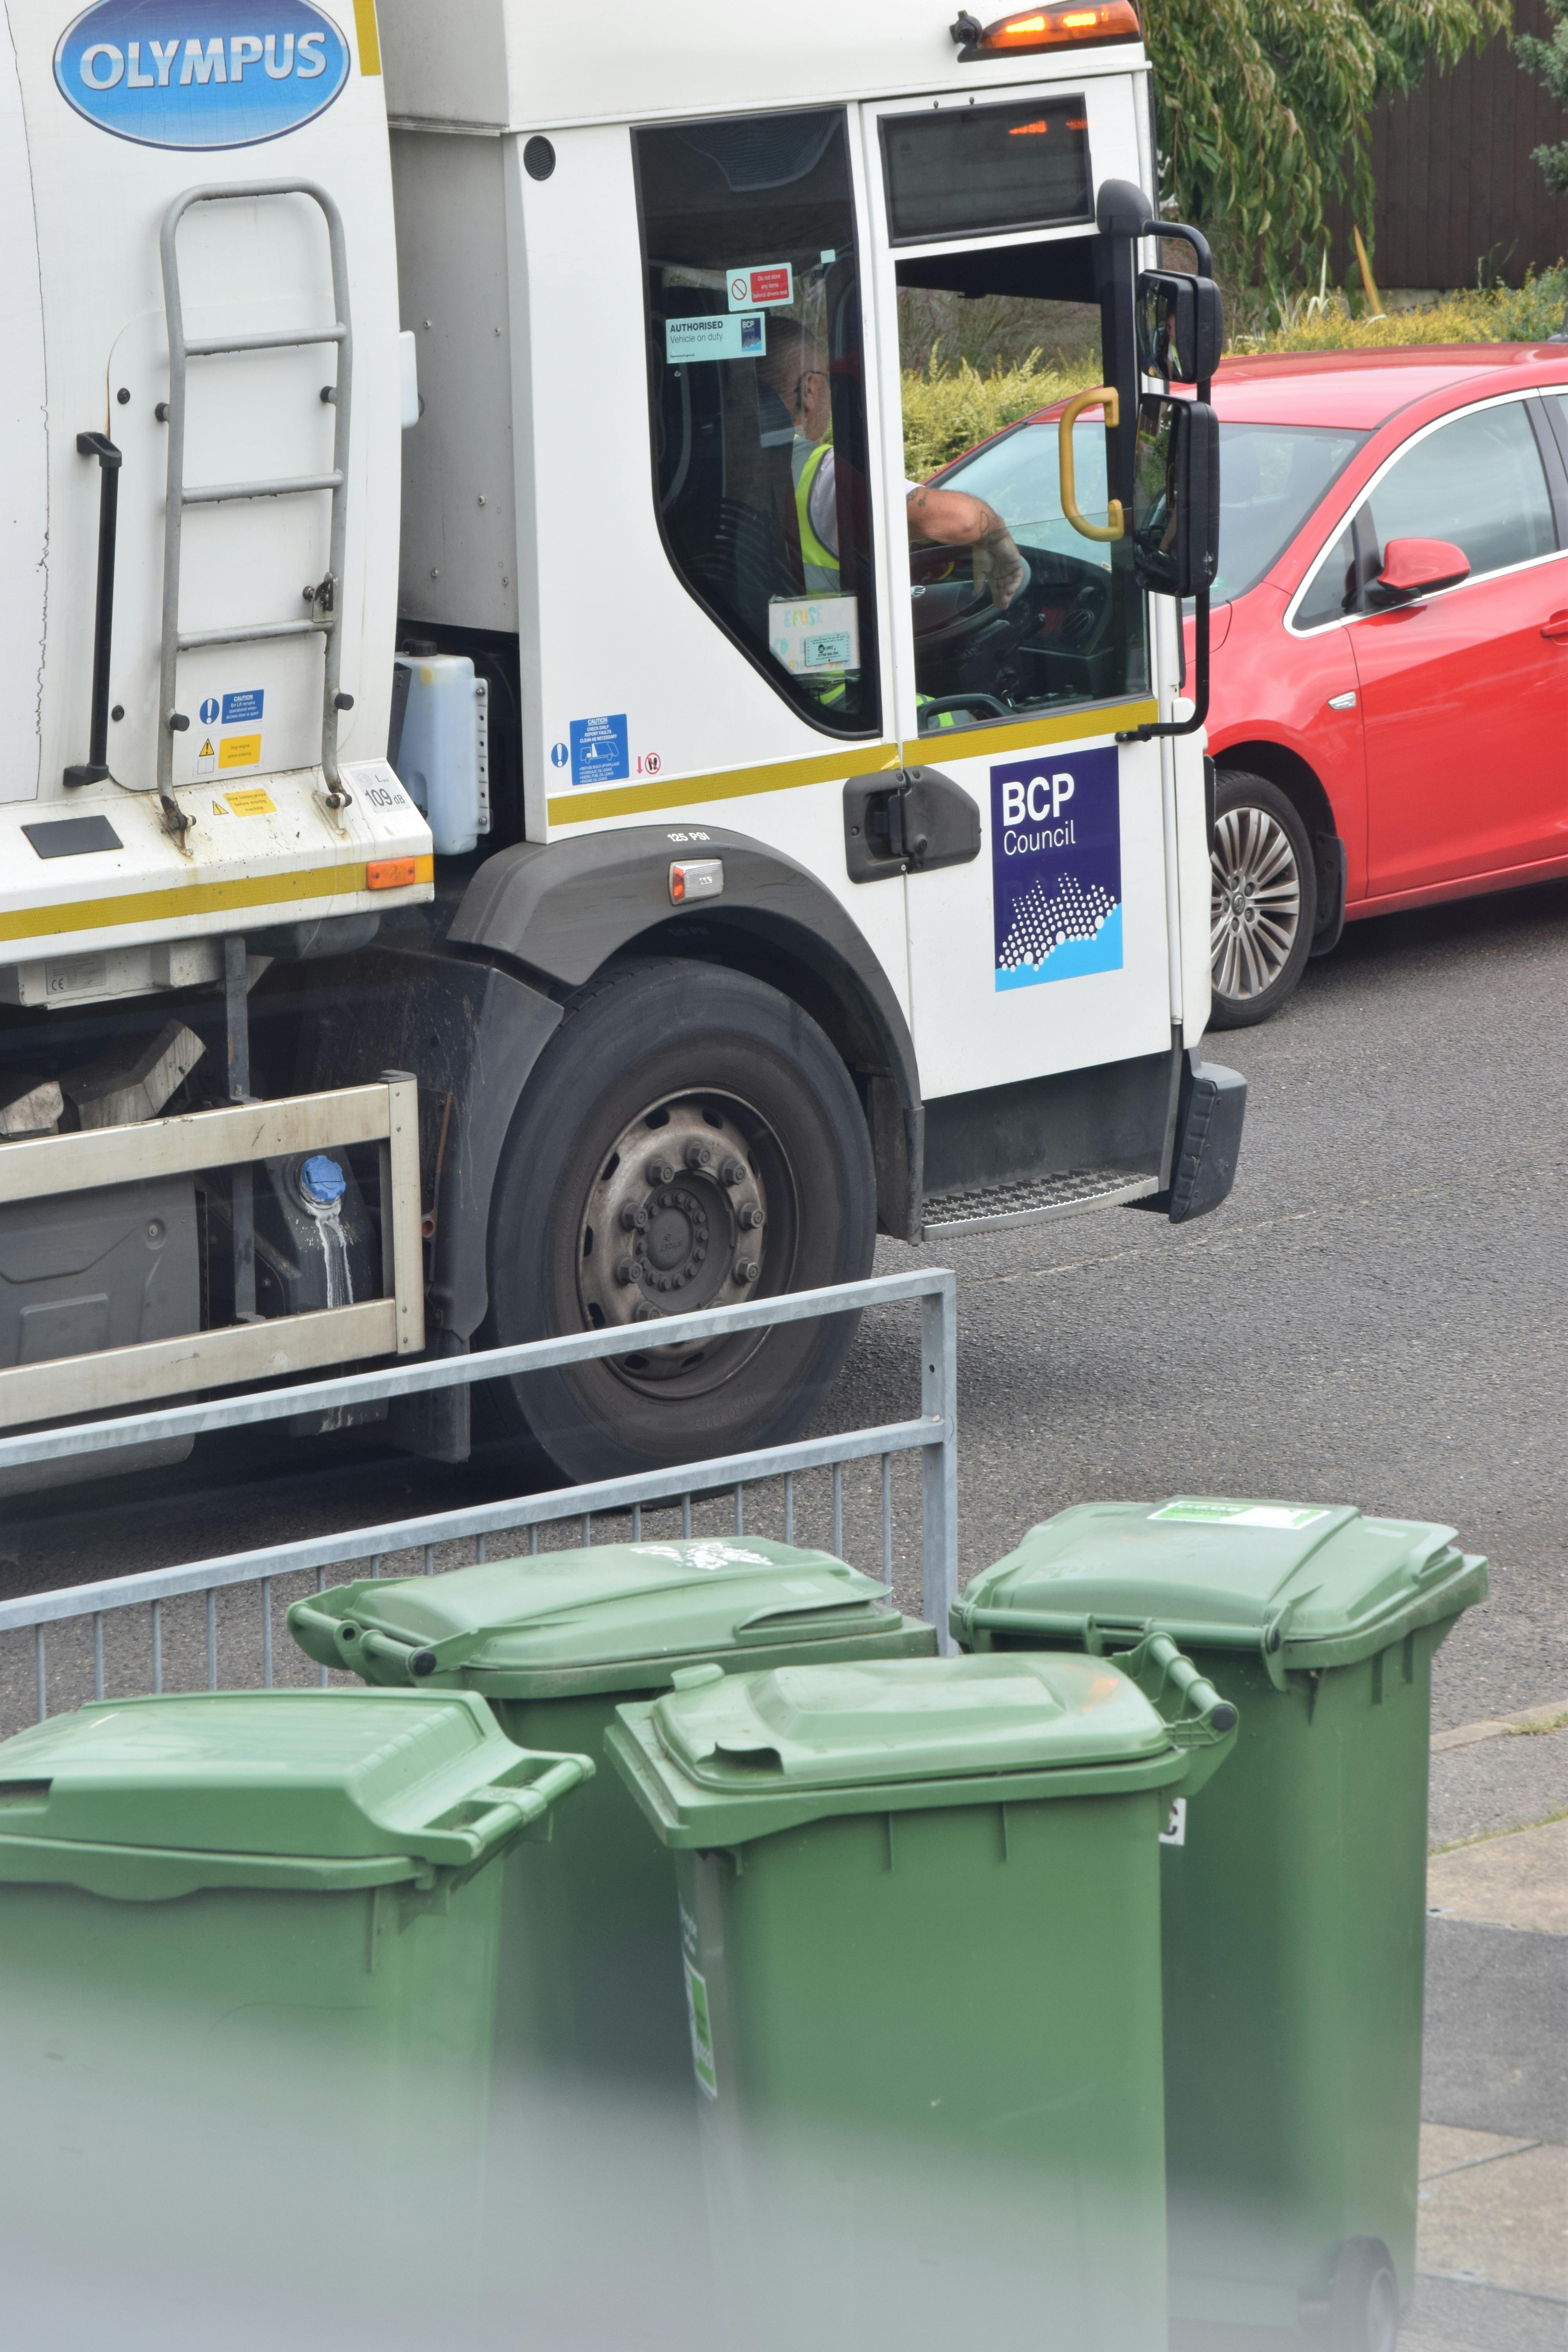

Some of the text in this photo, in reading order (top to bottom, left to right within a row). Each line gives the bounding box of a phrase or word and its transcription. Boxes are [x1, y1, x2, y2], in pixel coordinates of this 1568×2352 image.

[80, 32, 327, 91] OLYMPUS
[670, 321, 723, 333] AUTHORISED
[670, 334, 695, 344] Vehicle
[708, 332, 723, 342] duty
[365, 788, 405, 807] 109 dB
[1002, 773, 1075, 826] BCP
[667, 832, 711, 842] 125 PSI
[1004, 819, 1076, 855] Council
